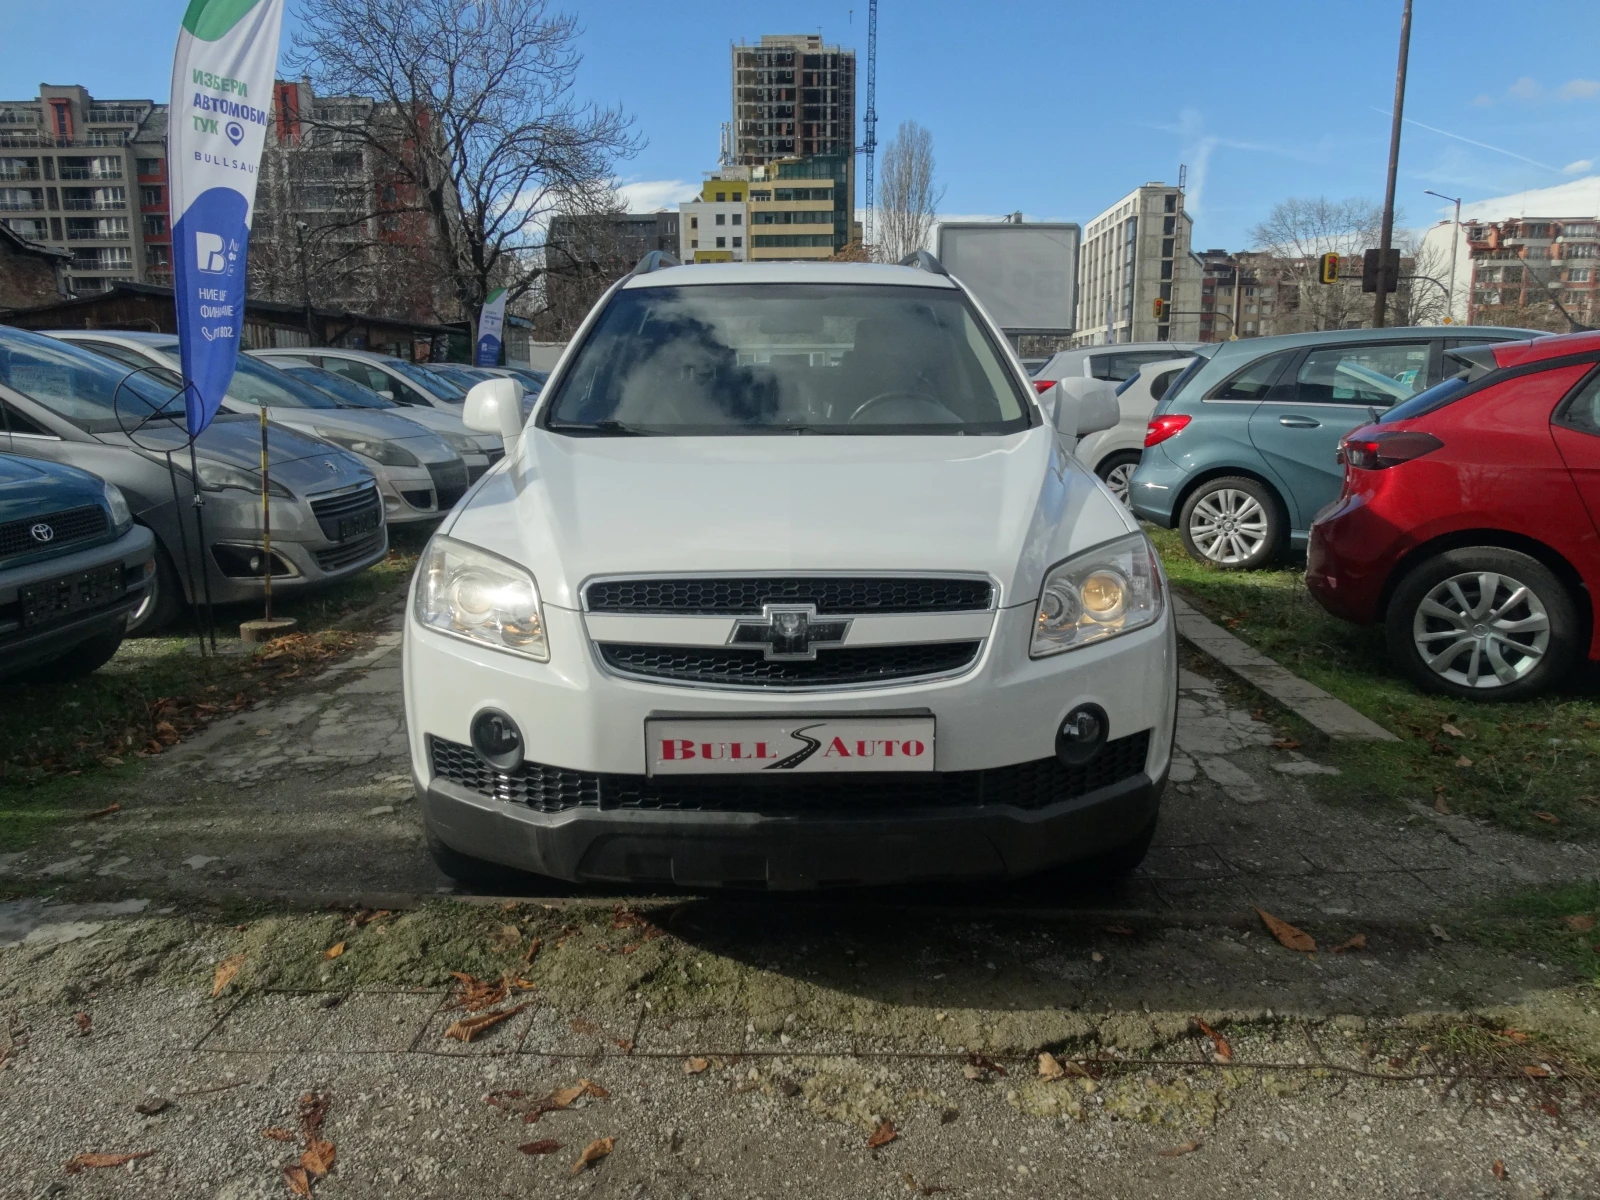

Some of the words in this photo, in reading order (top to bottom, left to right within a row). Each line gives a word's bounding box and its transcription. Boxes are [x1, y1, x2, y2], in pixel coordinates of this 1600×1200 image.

[192, 68, 248, 98] ИЗБЕРИ
[192, 115, 219, 135] ТУК
[198, 287, 219, 301] НИЕ
[658, 738, 777, 761] BULL
[823, 736, 925, 758] AUTO
